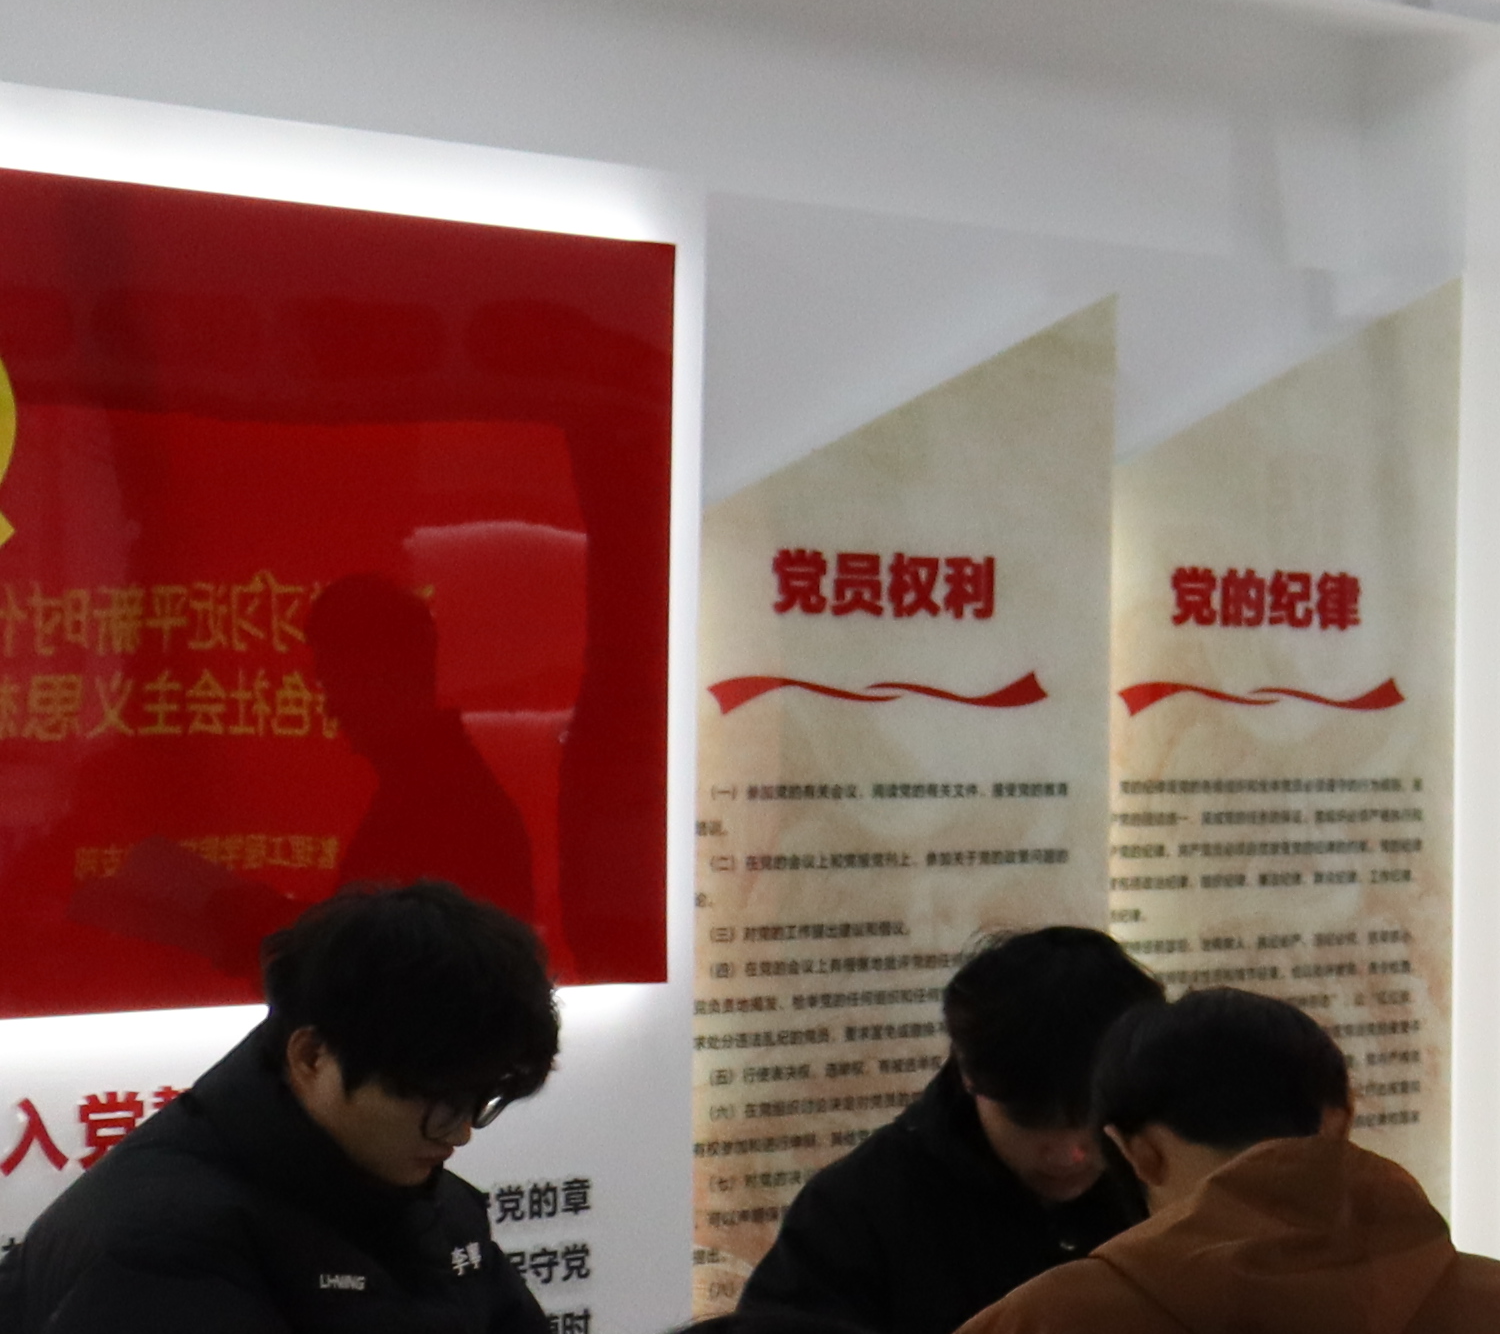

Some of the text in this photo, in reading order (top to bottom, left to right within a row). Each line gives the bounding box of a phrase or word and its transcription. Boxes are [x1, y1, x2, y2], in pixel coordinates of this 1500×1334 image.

[772, 548, 996, 620] 党员权利
[1170, 566, 1362, 631] 党的纪律
[0, 1086, 192, 1177] 入党
[484, 1178, 591, 1224] 党的章
